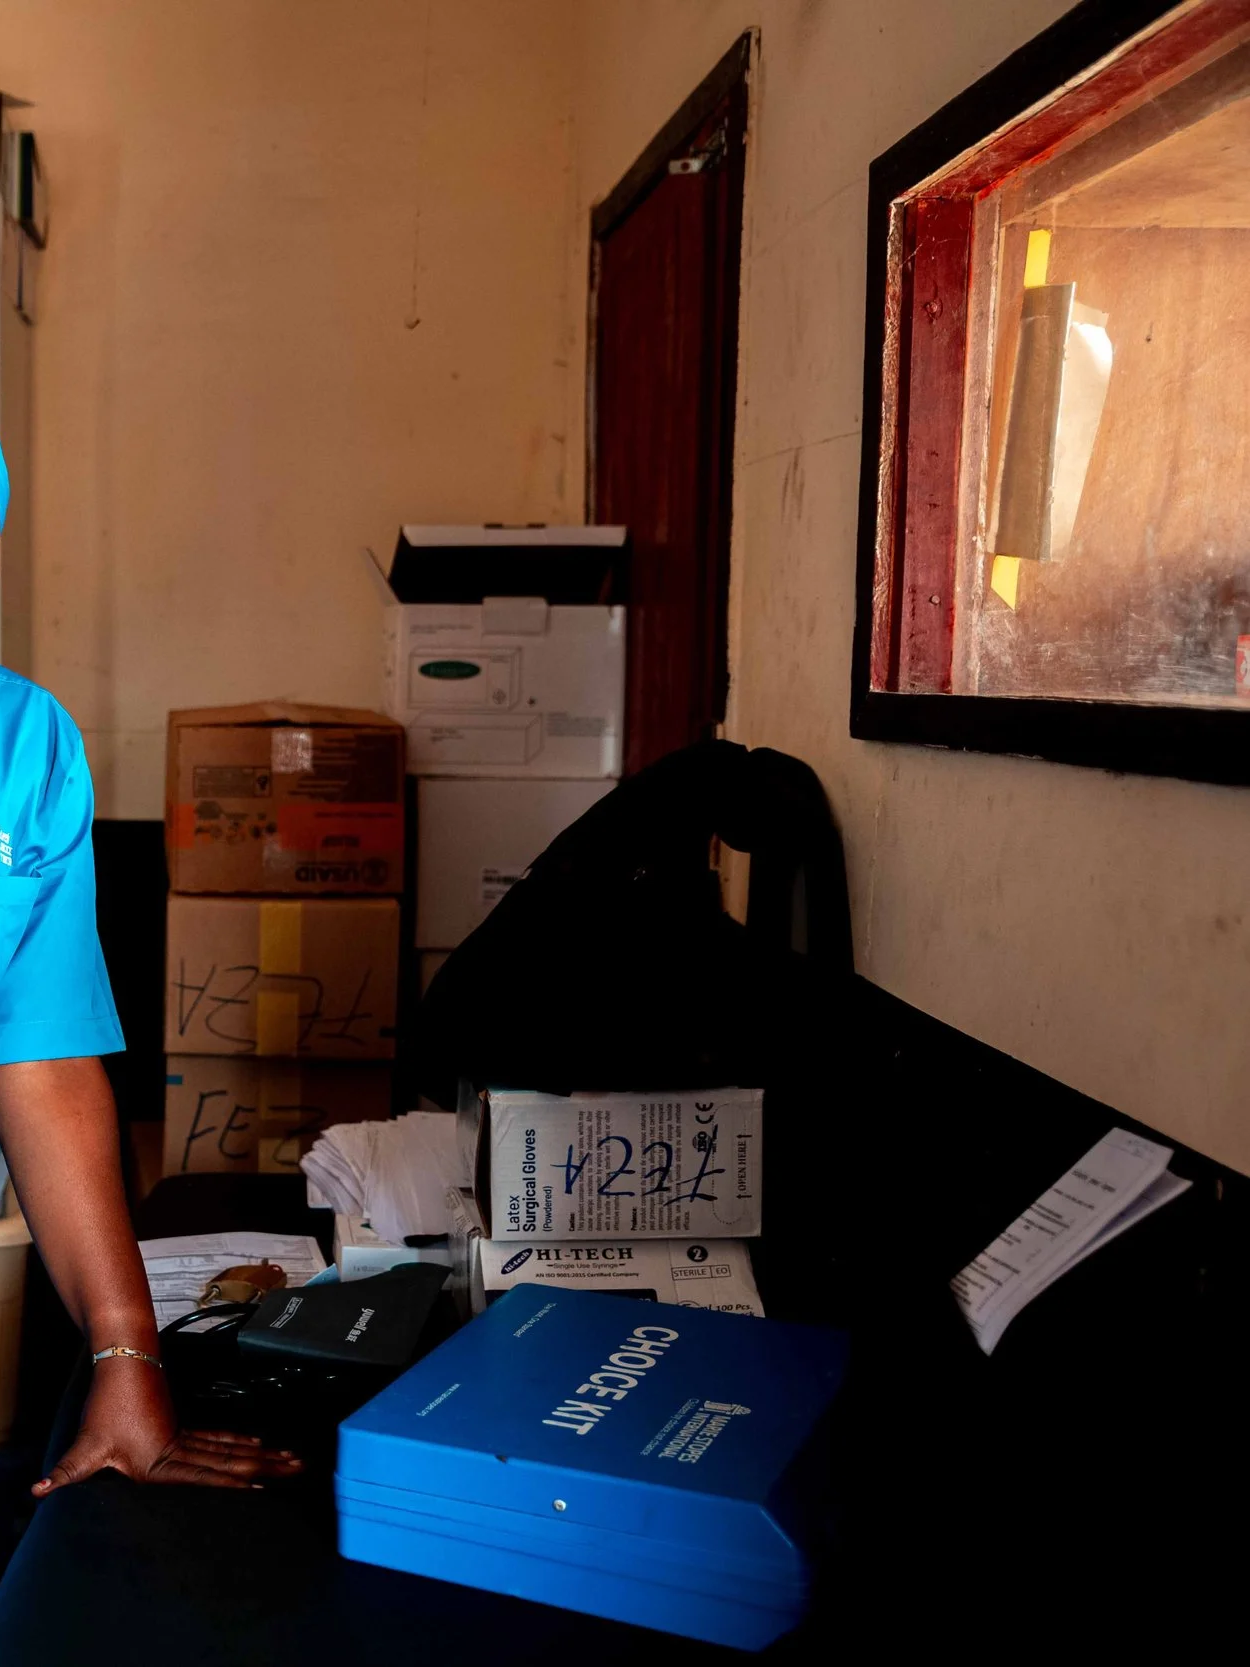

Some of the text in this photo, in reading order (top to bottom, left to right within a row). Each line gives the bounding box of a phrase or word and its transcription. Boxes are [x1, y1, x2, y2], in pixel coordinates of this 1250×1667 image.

[295, 867, 359, 882] USAID
[523, 1130, 539, 1232] Surgical Gloves
[738, 1141, 747, 1192] OPEN HERE
[507, 1196, 519, 1232] Latex
[543, 1187, 553, 1232] (Powdered)
[504, 1250, 530, 1272] hi-tech
[536, 1248, 633, 1260] HI-TECH
[592, 1262, 618, 1270] Syringe
[693, 1249, 702, 1260] 2
[674, 1269, 706, 1277] STERILE
[542, 1326, 679, 1436] CHOICE KIT
[658, 1412, 710, 1458] INTERNATIONAL
[678, 1414, 730, 1464] MARIE STOPES
